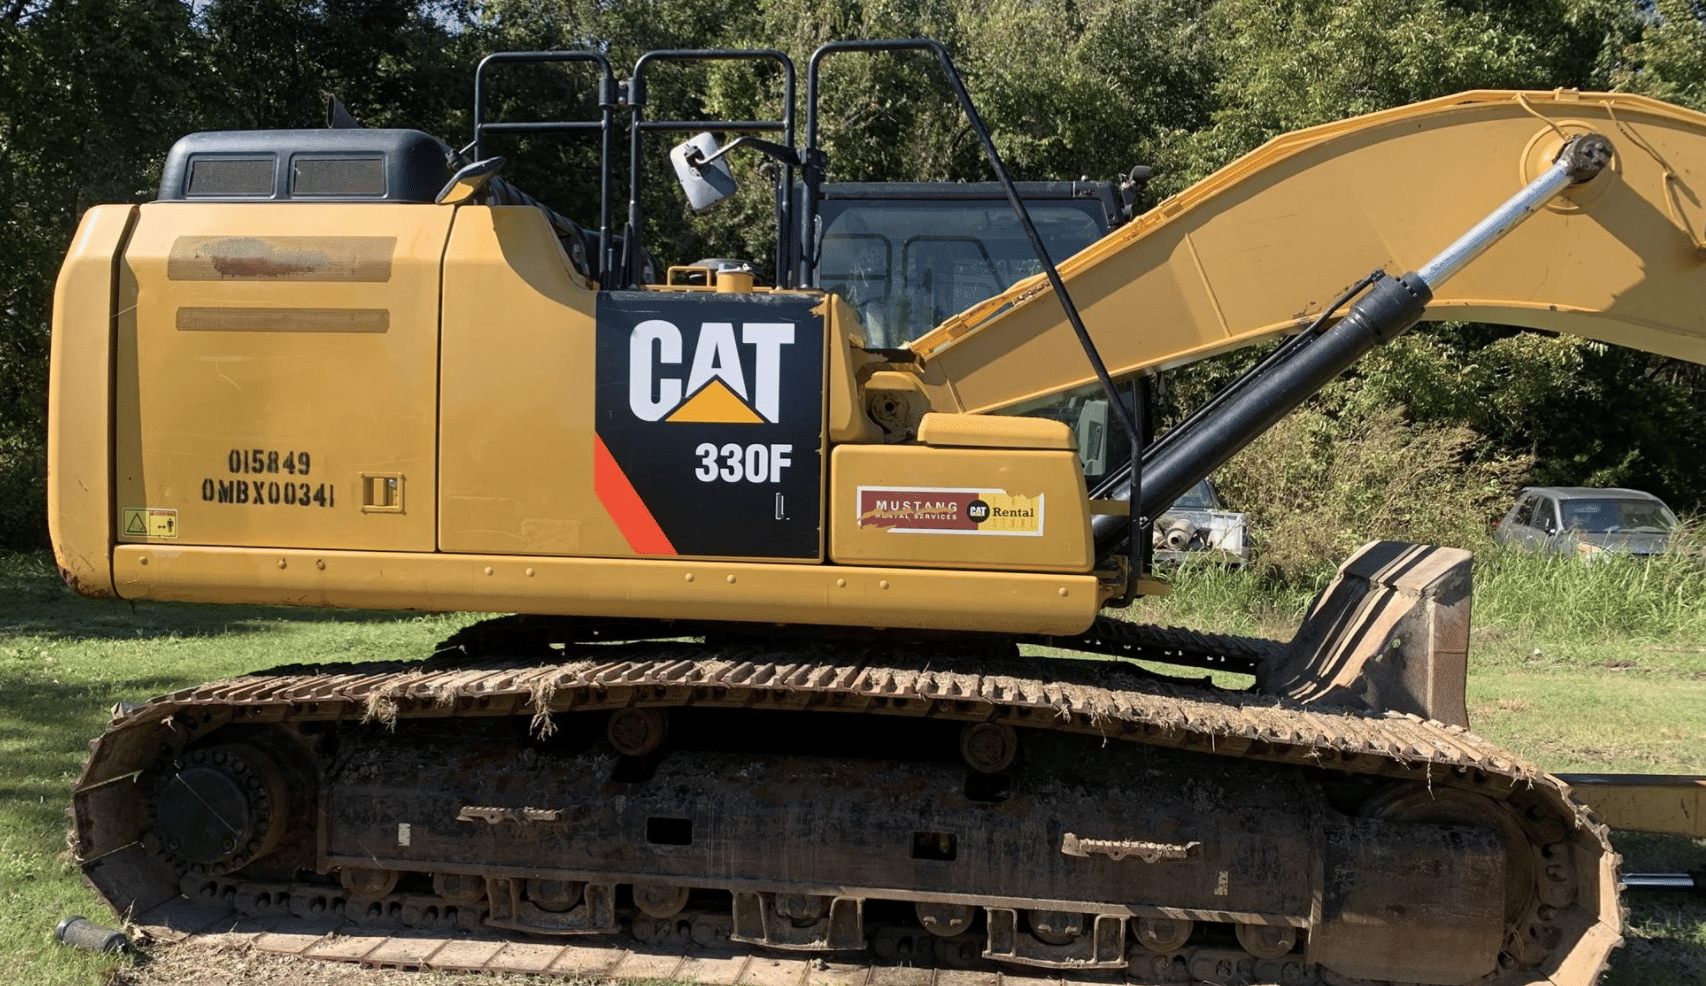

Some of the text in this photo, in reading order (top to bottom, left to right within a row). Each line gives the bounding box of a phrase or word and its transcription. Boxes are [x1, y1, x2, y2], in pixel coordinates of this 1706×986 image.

[629, 319, 796, 424] CAT
[228, 448, 311, 476] 015849
[694, 442, 793, 484] 330F
[876, 500, 958, 513] MUSTANG
[970, 505, 1034, 518] CAT Rental
[914, 513, 958, 521] SERVICES
